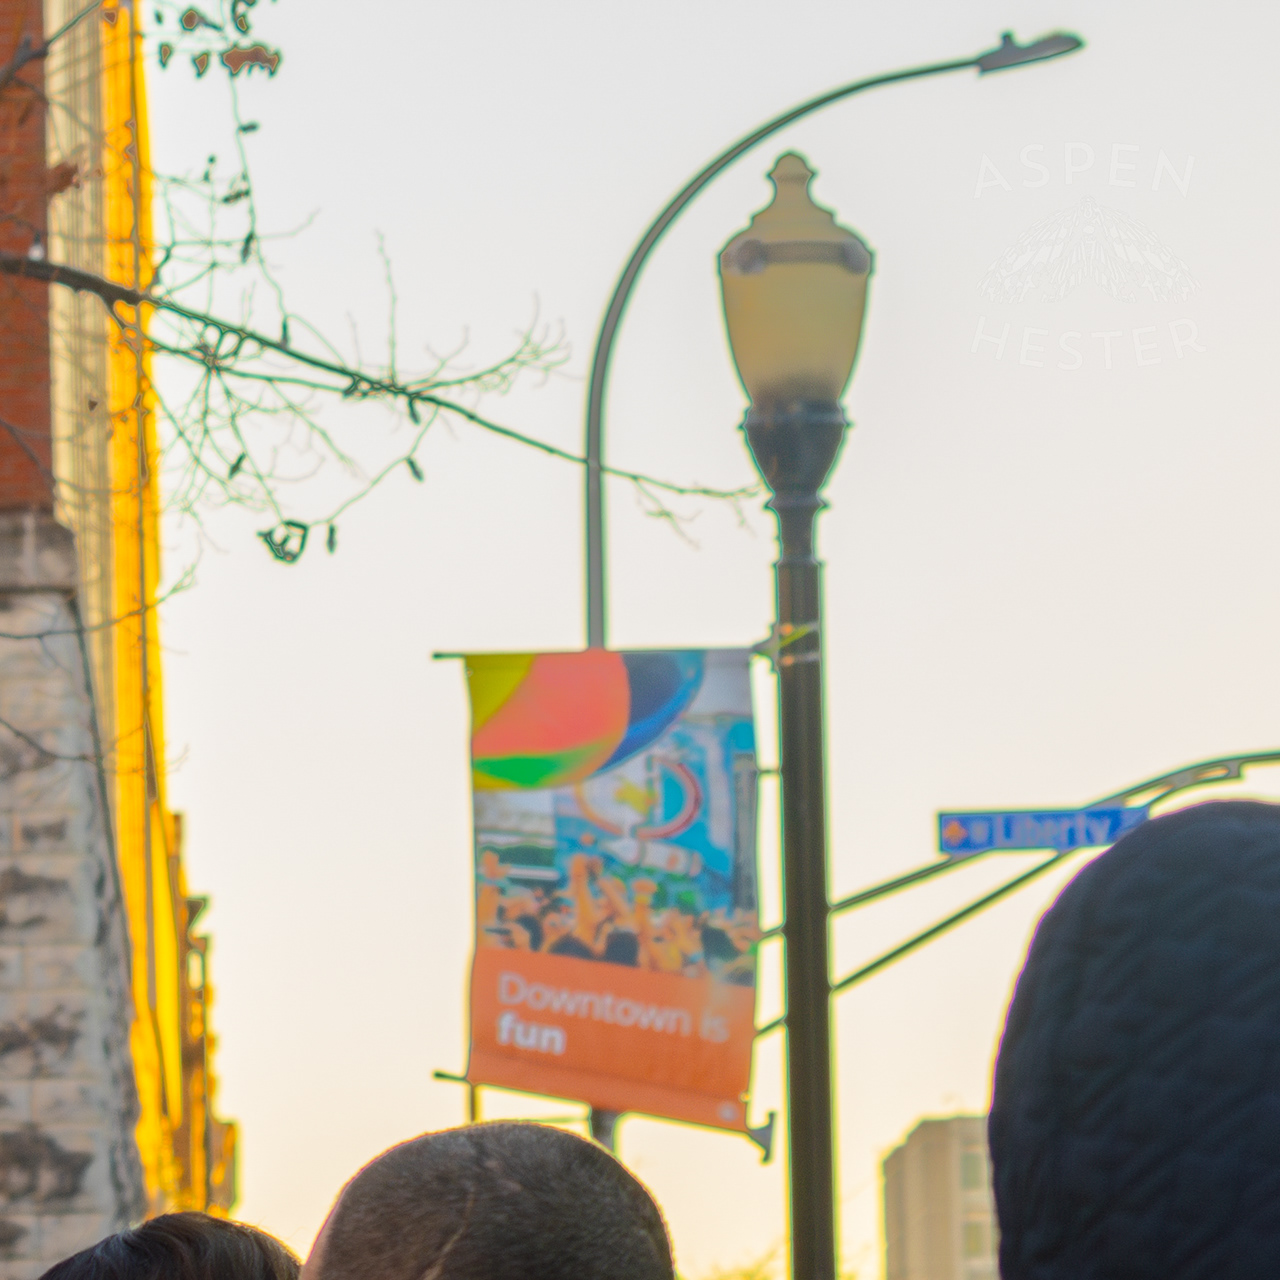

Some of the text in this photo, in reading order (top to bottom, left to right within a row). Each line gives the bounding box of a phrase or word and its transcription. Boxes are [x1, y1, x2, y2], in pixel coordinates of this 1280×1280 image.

[496, 1010, 567, 1056] fun
[497, 970, 730, 1043] Downtown is
